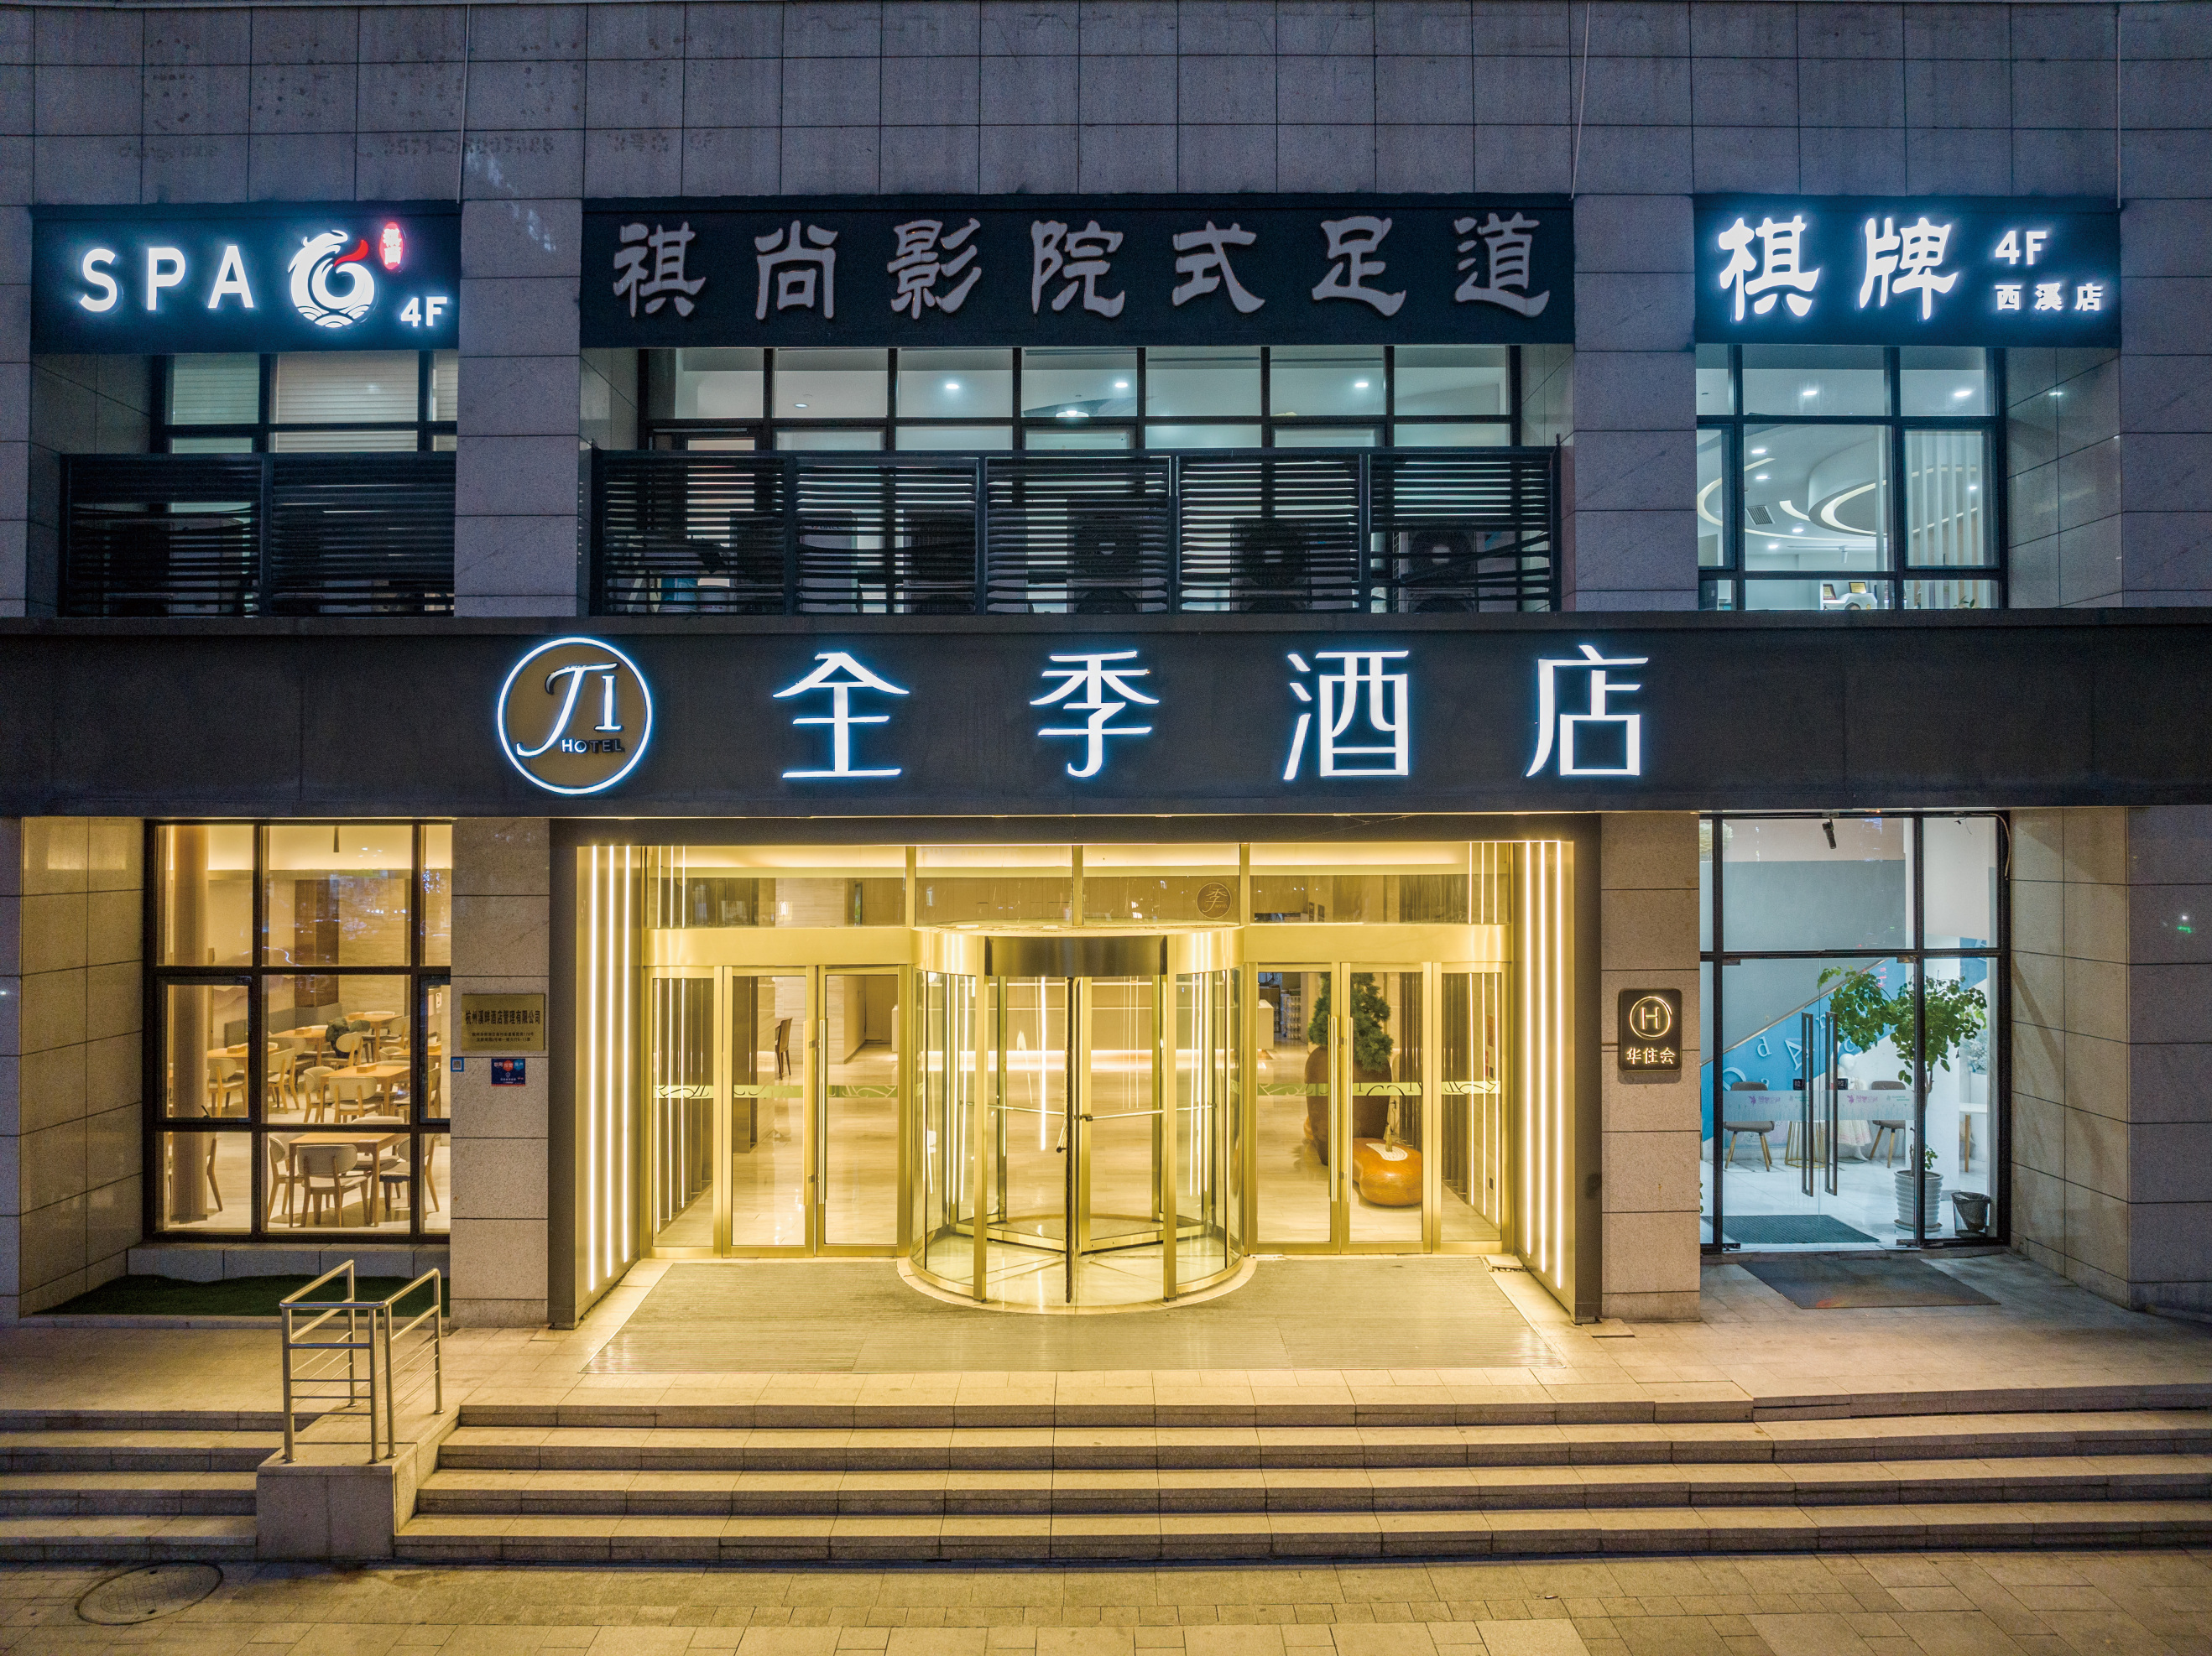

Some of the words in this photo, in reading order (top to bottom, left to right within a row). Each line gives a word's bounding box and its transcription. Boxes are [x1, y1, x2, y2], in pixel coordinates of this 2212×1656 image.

[1995, 230, 2048, 265] 4F
[80, 244, 254, 312] SPA
[613, 212, 1550, 320] 祺尚影院式足道
[1718, 215, 1959, 321] 棋牌
[400, 296, 448, 328] 4F
[1995, 283, 2103, 311] 西溪店
[773, 644, 1648, 780] 全季酒店
[561, 738, 623, 753] HOTEL
[1626, 1046, 1676, 1065] 华住会
